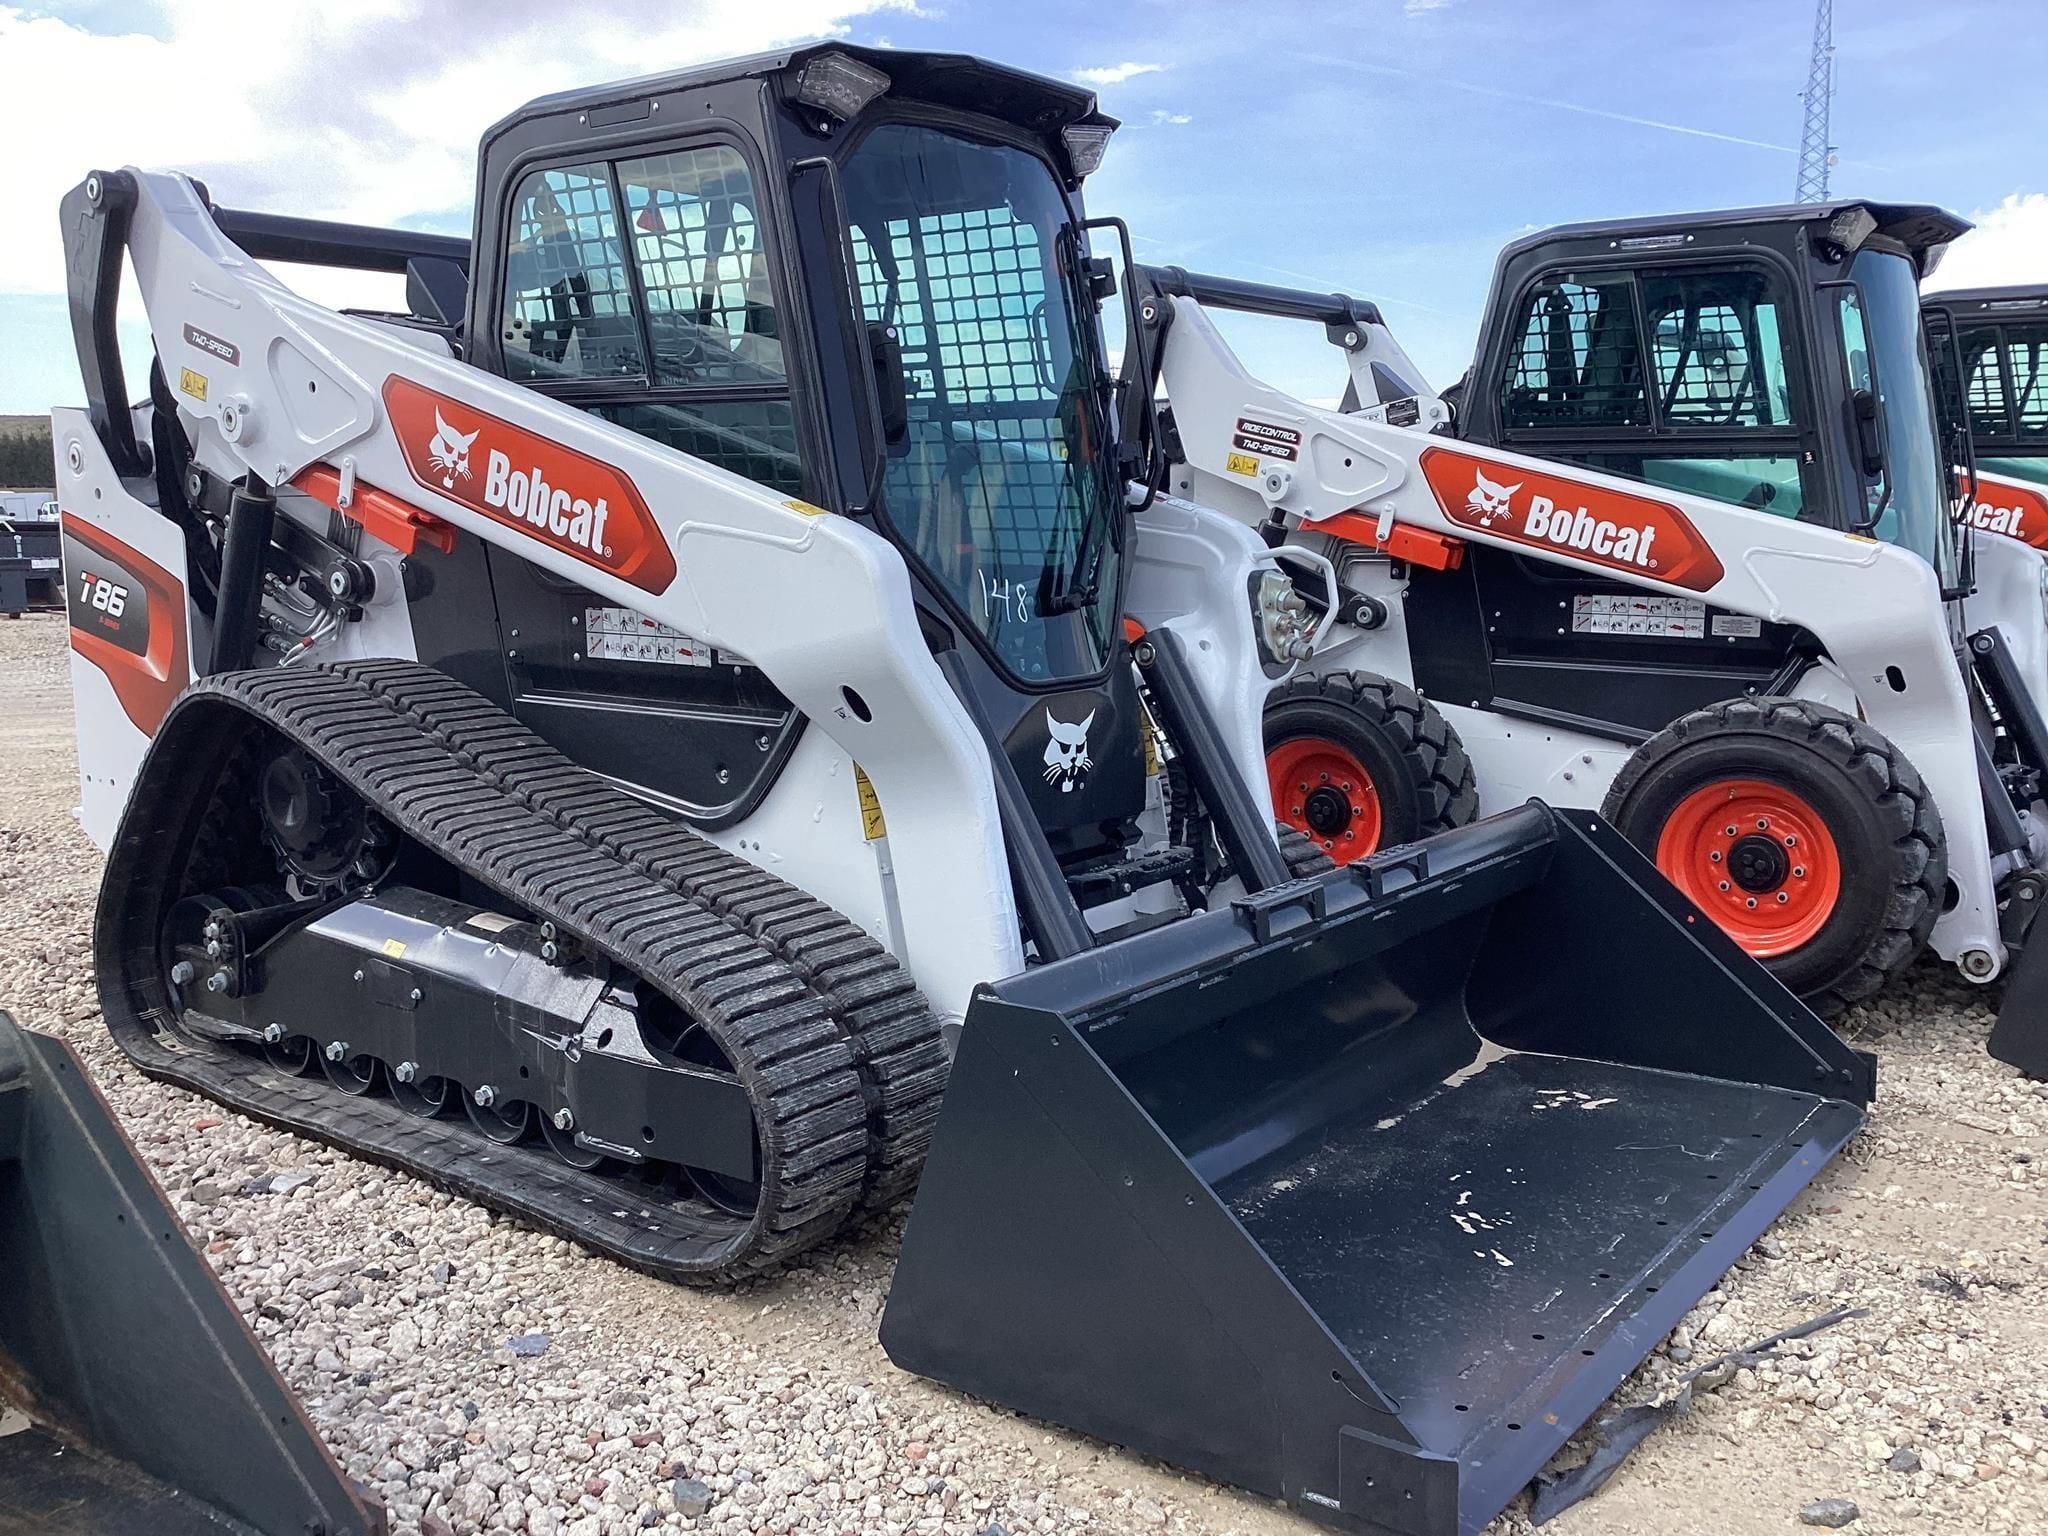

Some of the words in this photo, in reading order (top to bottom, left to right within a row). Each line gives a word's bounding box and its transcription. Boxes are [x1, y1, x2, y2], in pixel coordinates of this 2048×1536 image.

[192, 331, 234, 358] TWO-SPEED
[1241, 422, 1261, 433] RIDE
[1260, 427, 1297, 442] CONTROL
[1242, 439, 1290, 457] TWO-SPEED
[484, 448, 608, 555] Bobcat
[1523, 495, 1656, 567] Bobcat
[80, 571, 129, 618] T86
[978, 568, 1028, 623] 148
